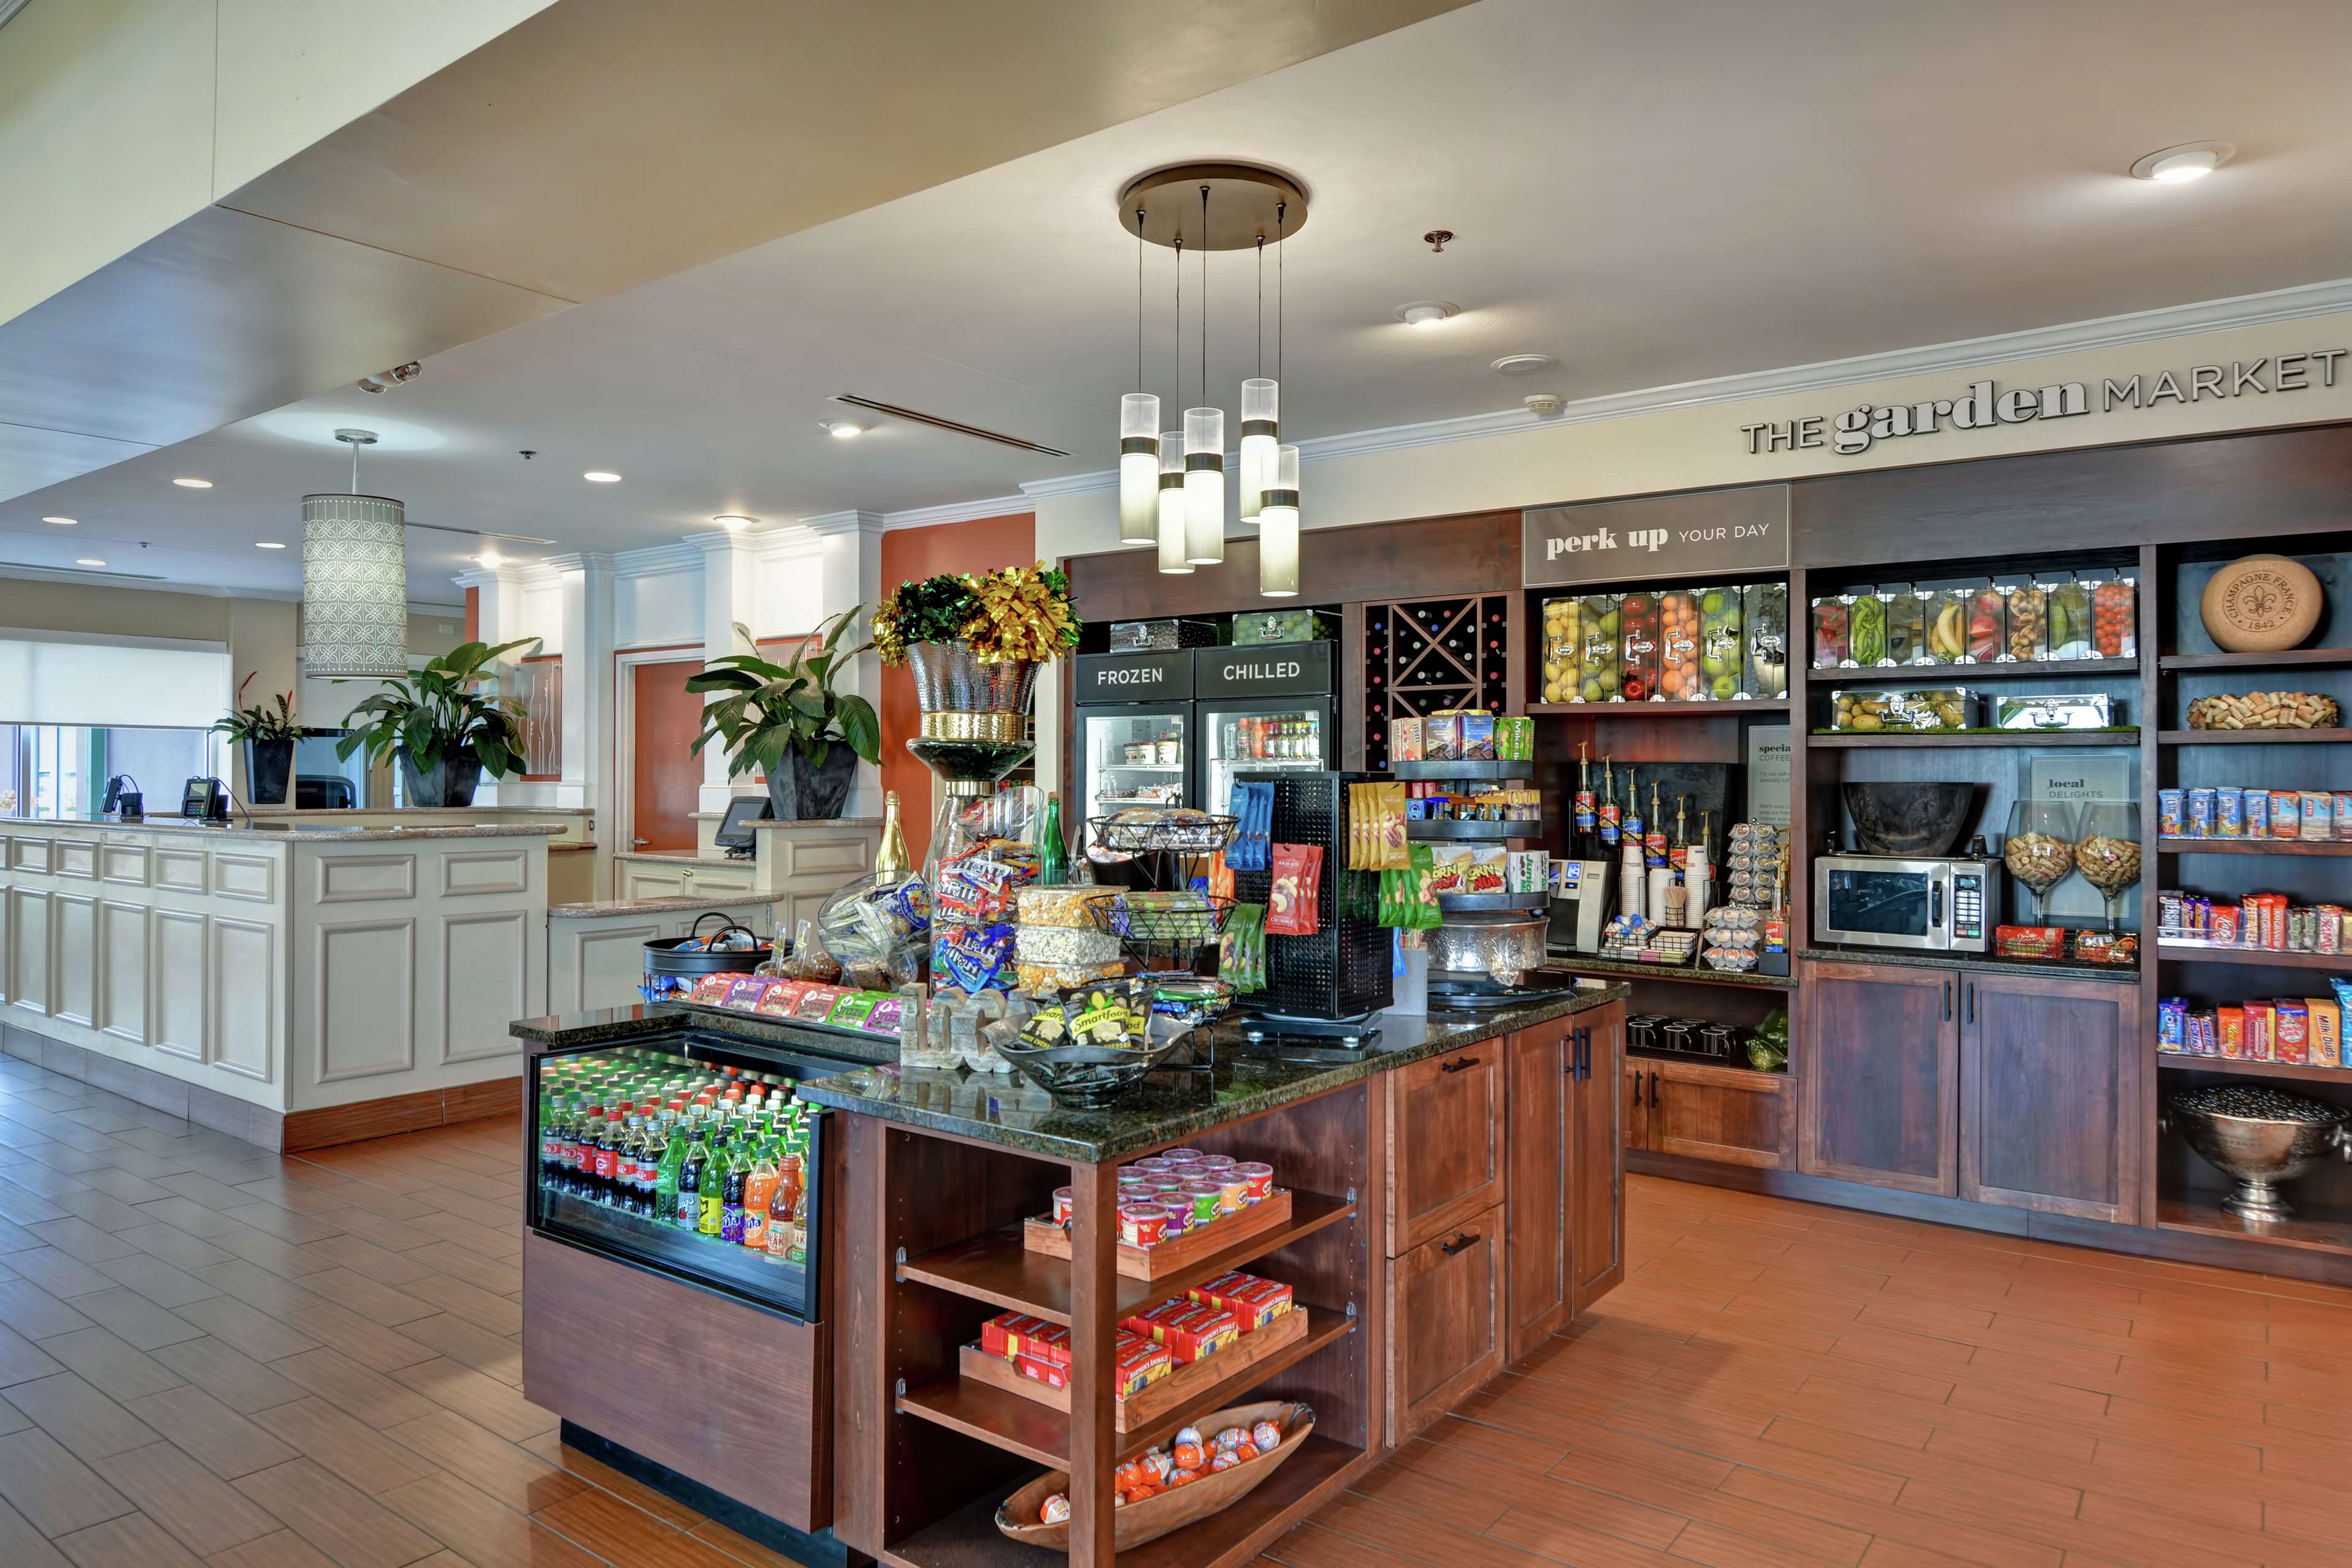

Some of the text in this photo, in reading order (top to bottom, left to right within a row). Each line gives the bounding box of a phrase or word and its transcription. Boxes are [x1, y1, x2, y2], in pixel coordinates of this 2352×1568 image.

[1741, 349, 2347, 455] THE garden MARKET
[1545, 523, 1770, 561] perk up YOUR DAY
[2226, 573, 2295, 619] CHAMPAGNE FRANCE
[2247, 620, 2275, 630] 1842
[1097, 667, 1163, 685] FROZEN
[1223, 662, 1301, 681] CHILLED
[2048, 778, 2084, 788] local
[763, 993, 794, 1007] graze
[835, 1006, 866, 1019] graze
[2316, 1014, 2336, 1059] Milk Duds
[1129, 1362, 1150, 1379] BARNUM'S
